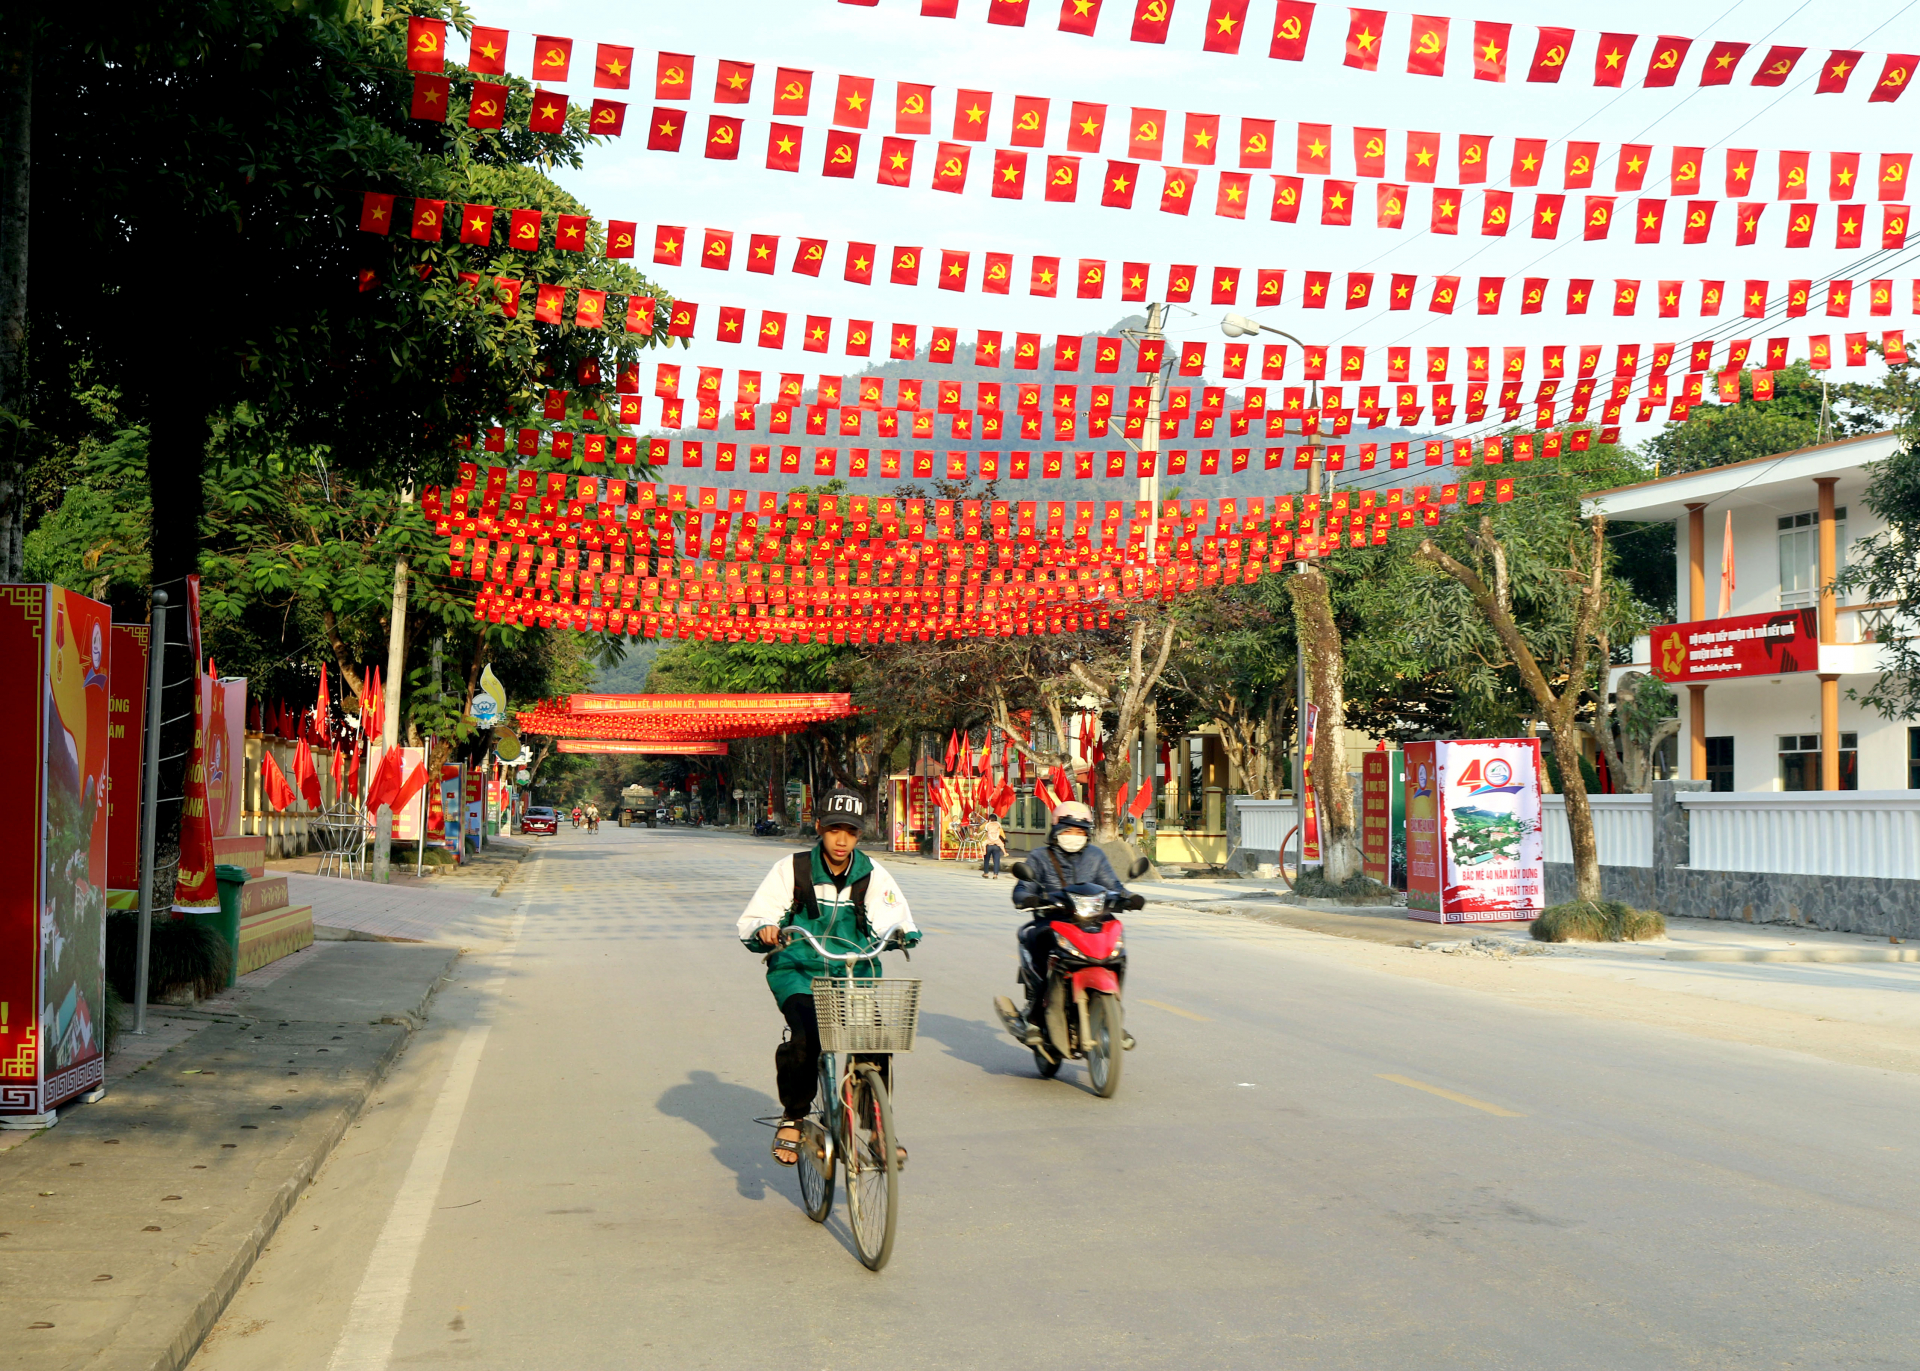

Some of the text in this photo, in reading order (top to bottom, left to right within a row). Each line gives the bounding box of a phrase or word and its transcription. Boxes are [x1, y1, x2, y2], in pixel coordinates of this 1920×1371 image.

[584, 699, 602, 709] ĐOÀN
[620, 699, 636, 709] ĐOÀN
[652, 700, 663, 710] ĐẠI
[664, 698, 682, 709] ĐOÀN
[698, 698, 718, 708] THÀNH
[109, 722, 124, 738] ÂM
[828, 798, 863, 815] ICON
[1462, 867, 1538, 881] BẮC MÊ 40 NĂM XÂY DỰNG
[1497, 880, 1538, 896] VÀ PHÁT TRIỂN
